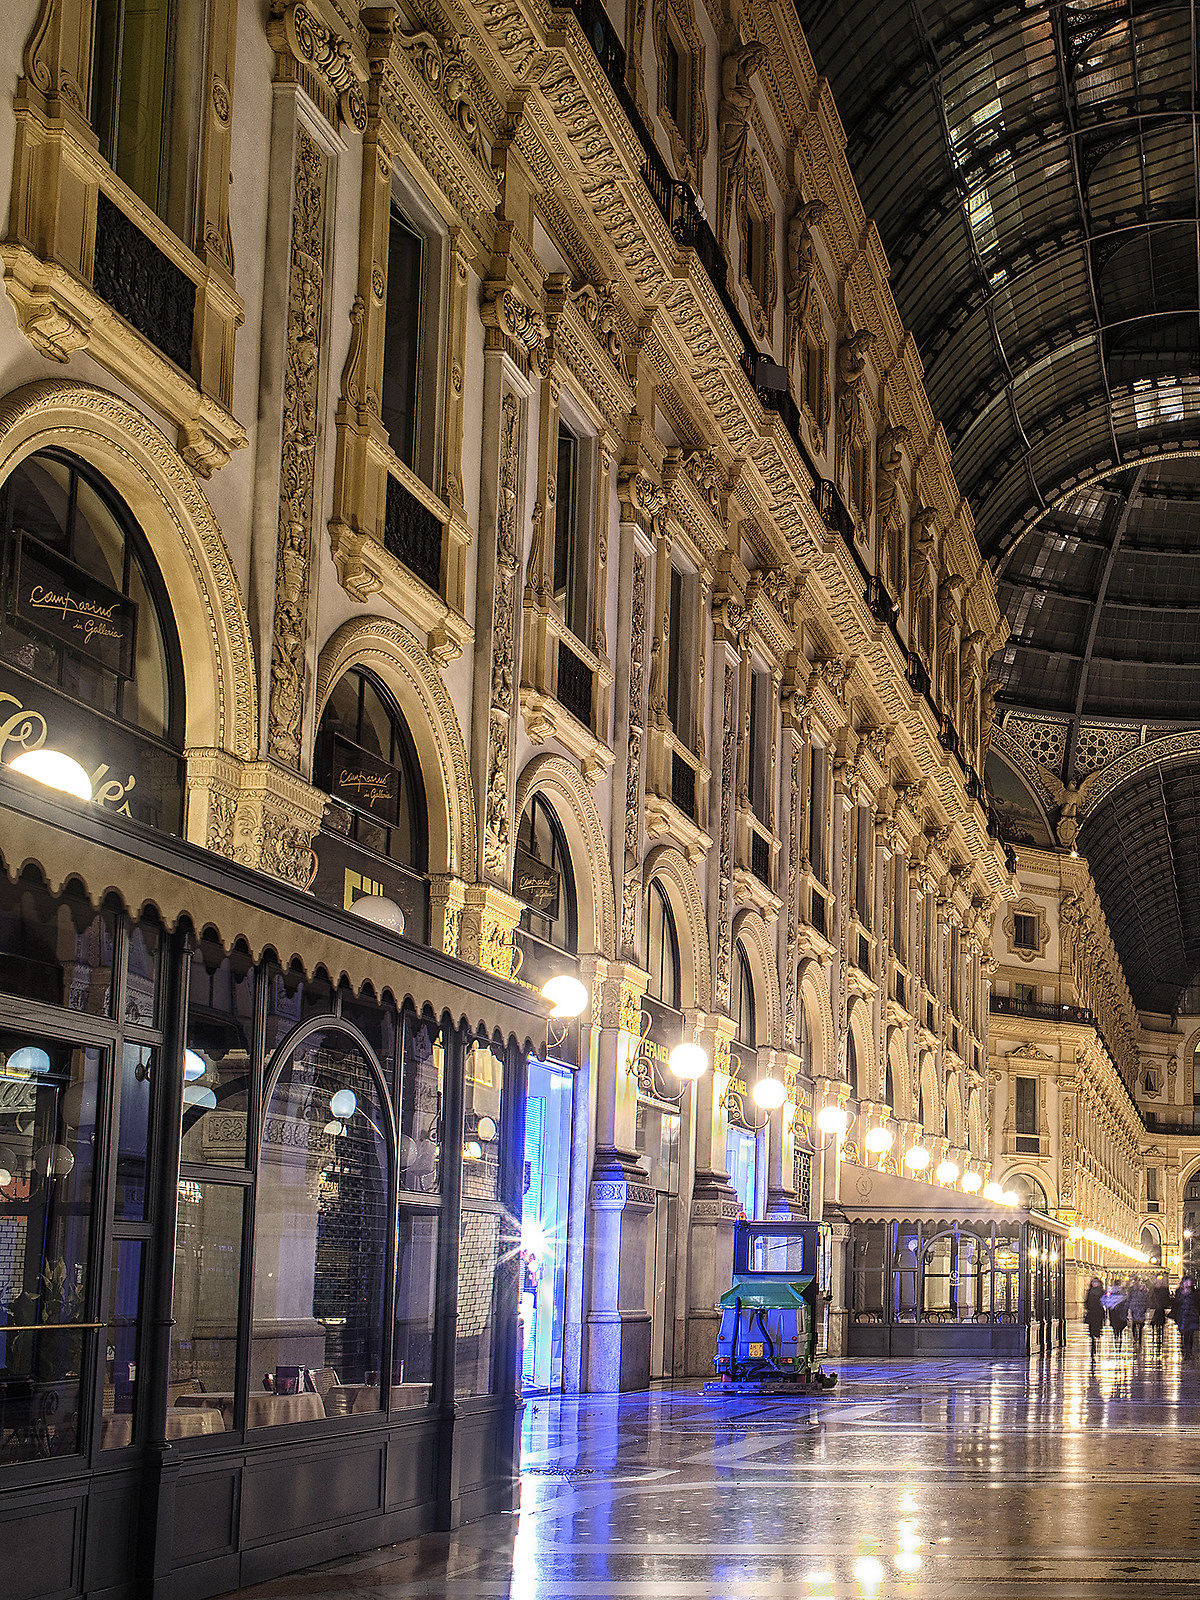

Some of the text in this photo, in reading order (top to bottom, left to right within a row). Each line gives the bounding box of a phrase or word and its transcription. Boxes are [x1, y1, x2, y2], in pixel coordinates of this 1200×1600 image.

[29, 585, 121, 622] Camparino
[72, 619, 124, 645] in Galleria
[338, 769, 392, 793] Camparino
